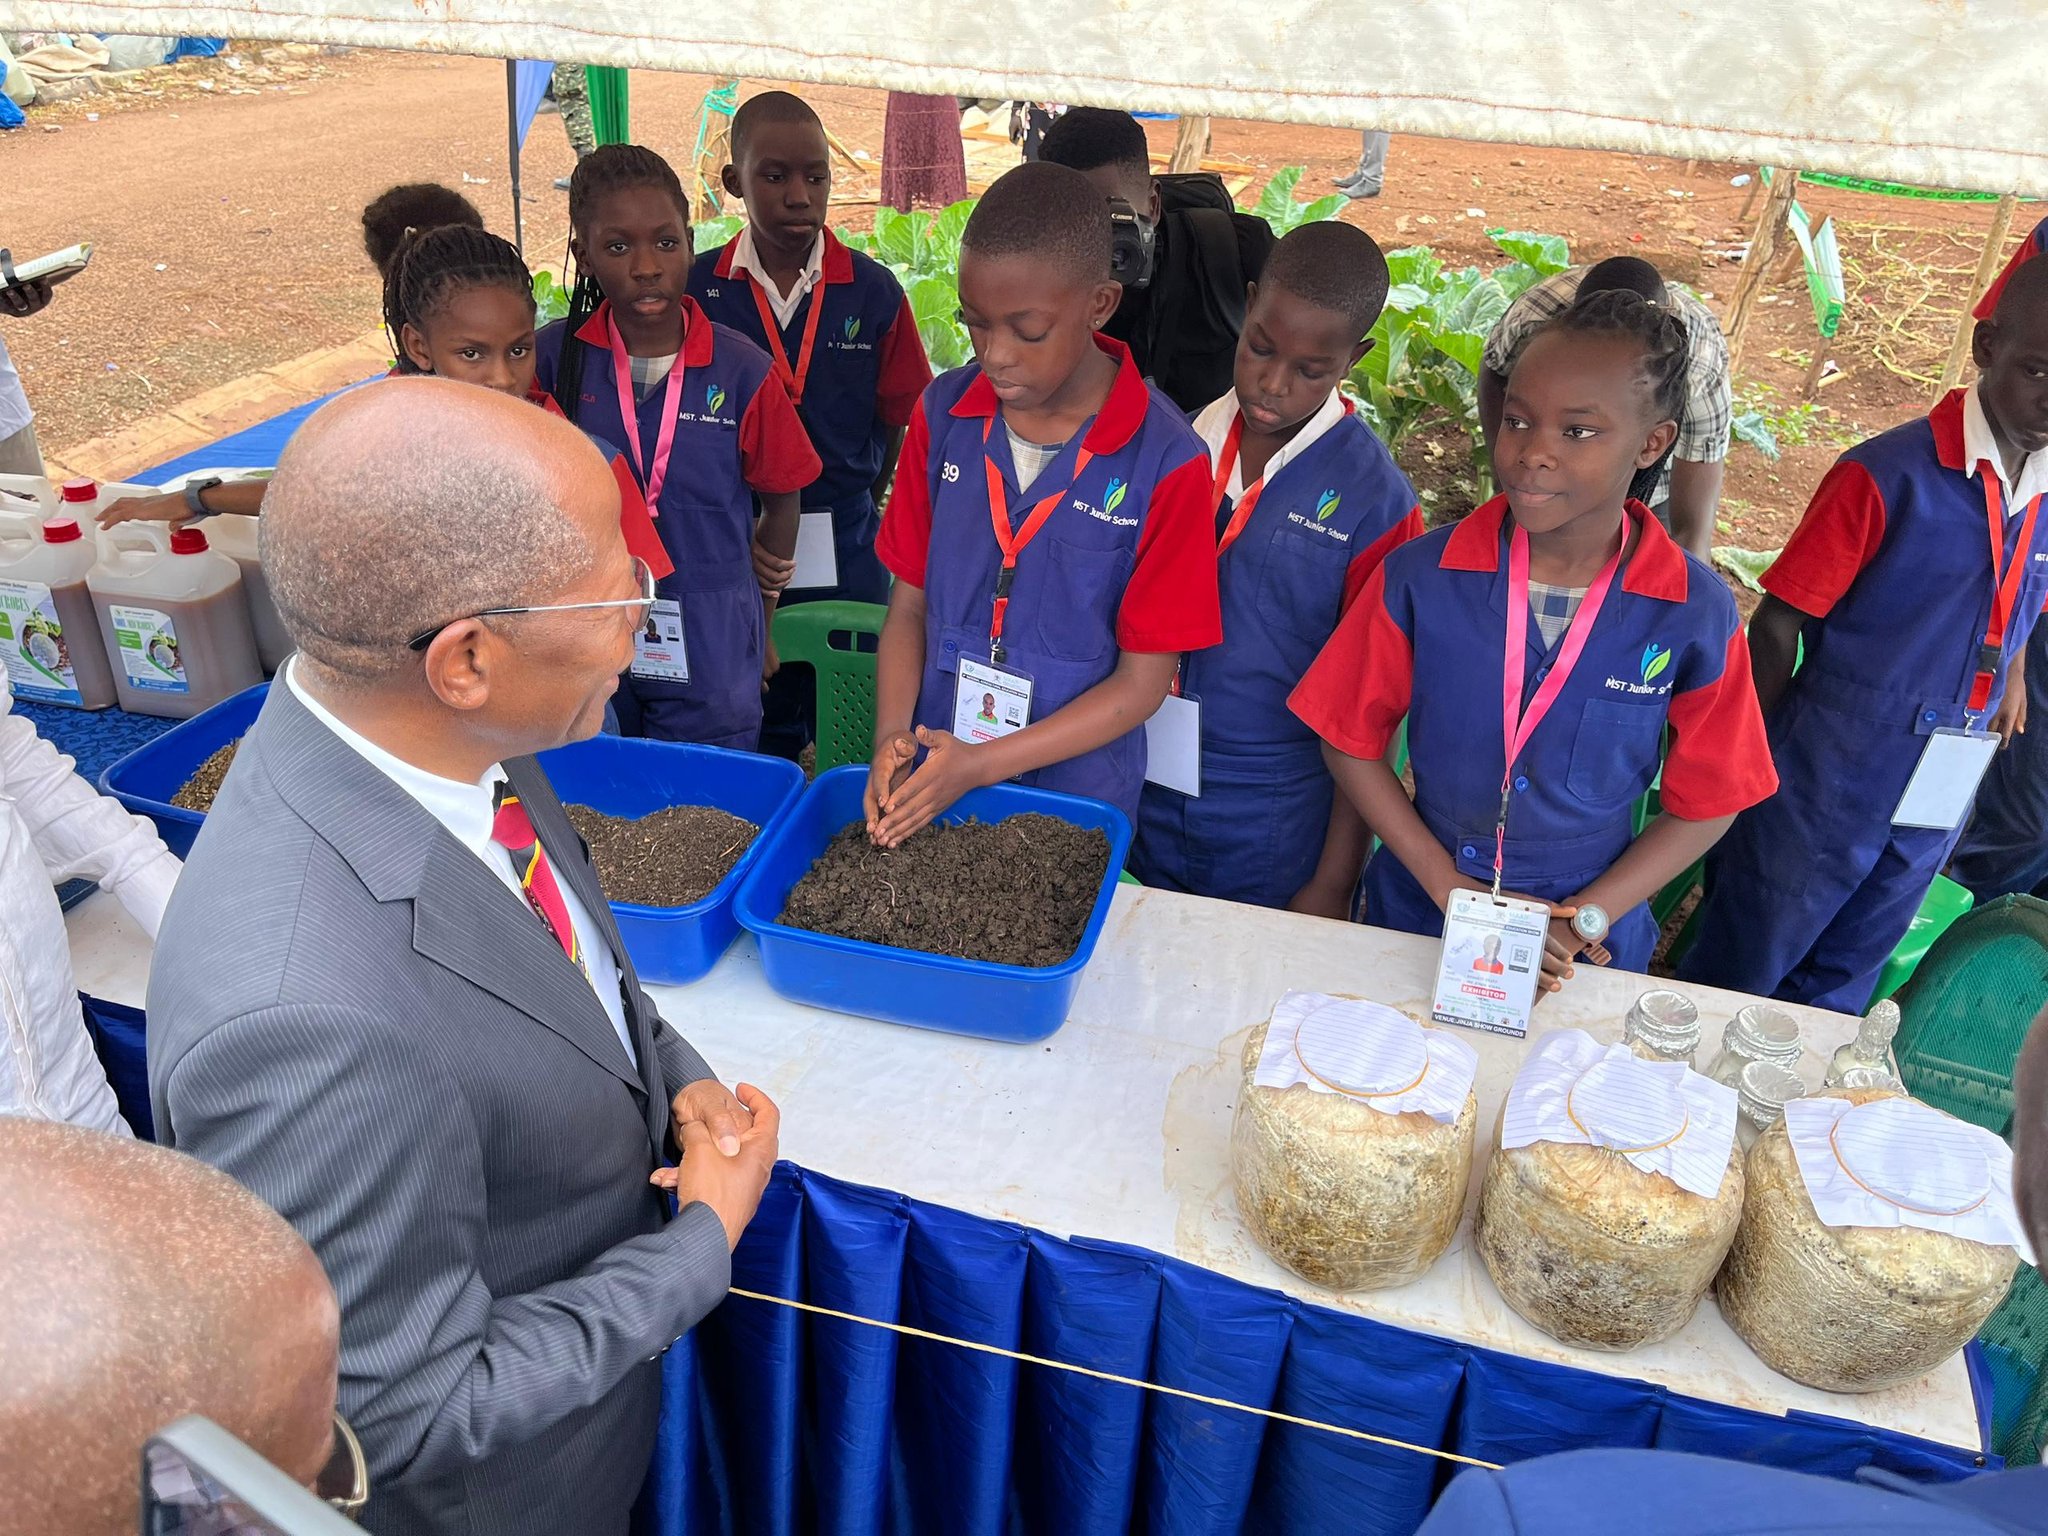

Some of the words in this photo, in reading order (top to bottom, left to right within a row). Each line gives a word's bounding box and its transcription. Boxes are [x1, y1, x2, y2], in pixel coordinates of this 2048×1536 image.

[706, 288, 720, 298] 141
[699, 414, 720, 423] Junior
[941, 461, 960, 483] 39
[1072, 499, 1090, 513] MST
[1089, 507, 1112, 522] Junior
[1112, 515, 1139, 527] School
[1287, 511, 1305, 524] MST
[1303, 518, 1327, 534] Junior
[1327, 527, 1349, 542] School
[1605, 677, 1628, 691] MST
[1627, 683, 1656, 695] Junior
[1462, 985, 1505, 999] EXHIBITOR
[1474, 1022, 1493, 1031] SHOW
[1493, 1026, 1524, 1037] GROUNDS
